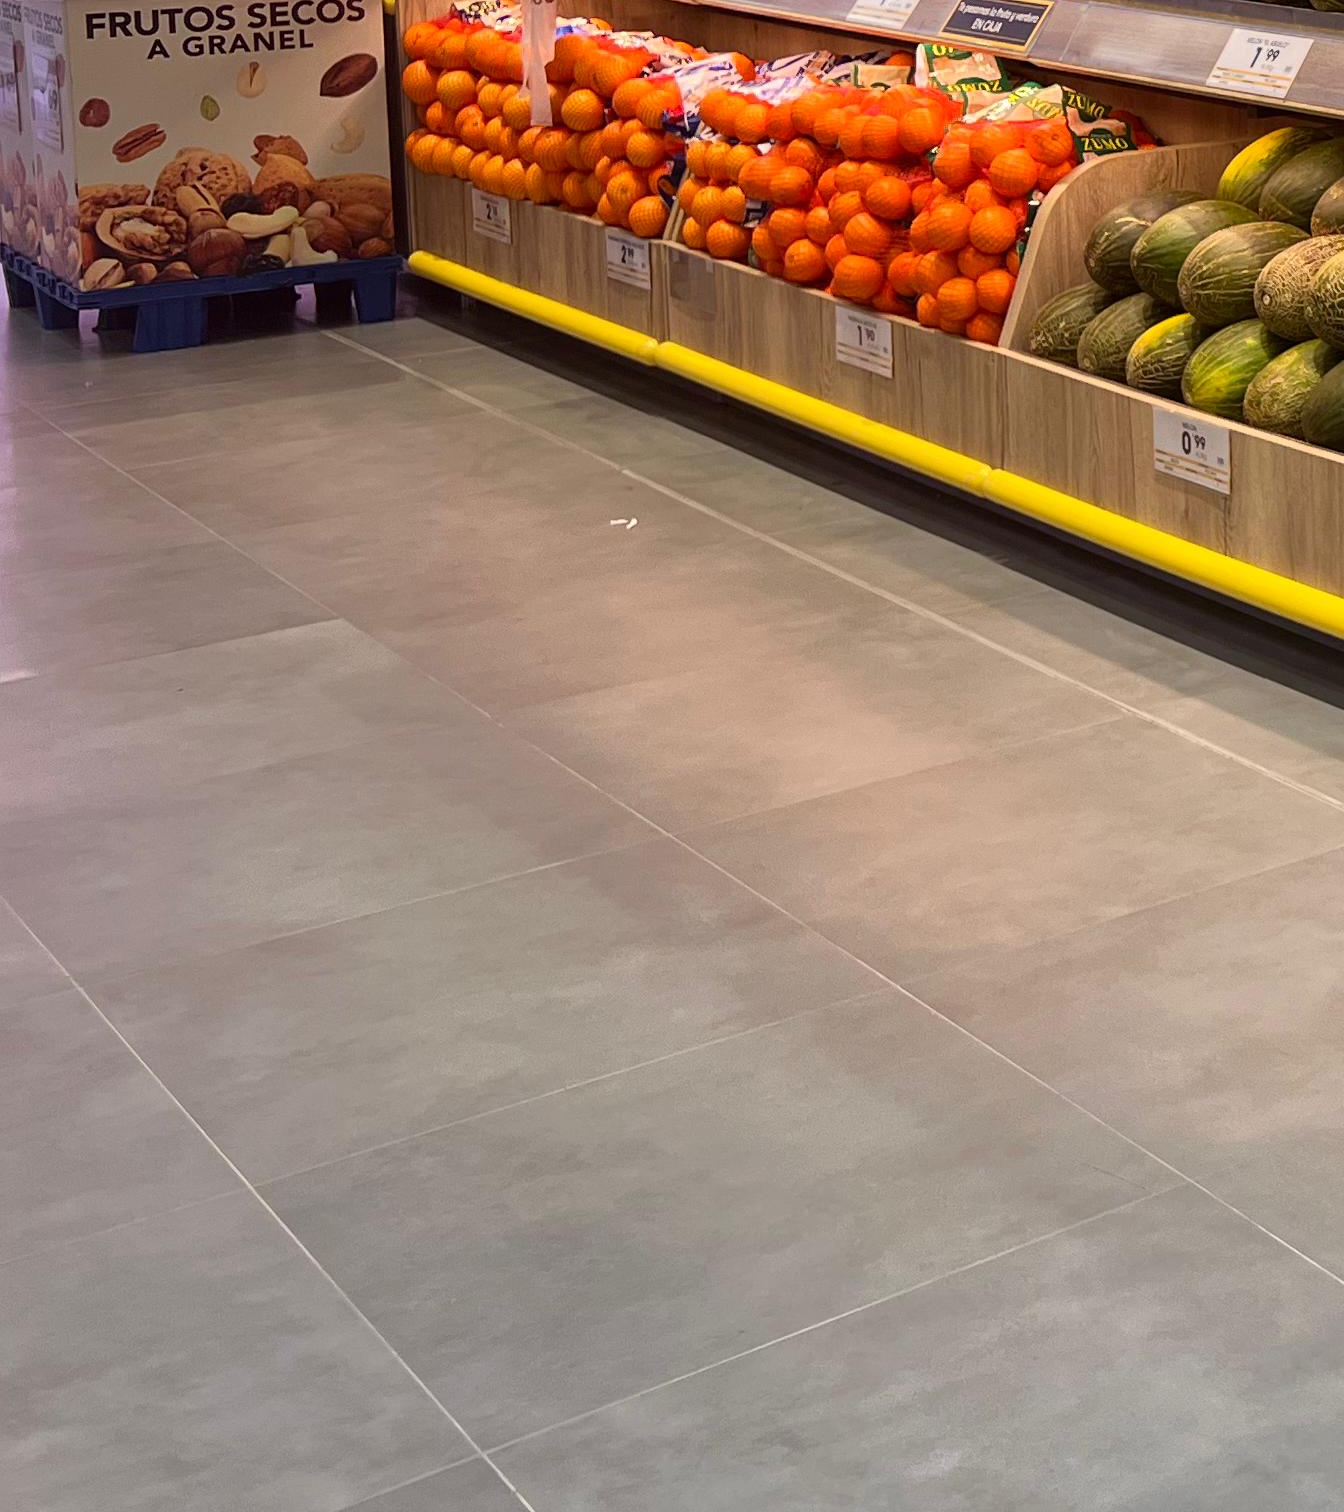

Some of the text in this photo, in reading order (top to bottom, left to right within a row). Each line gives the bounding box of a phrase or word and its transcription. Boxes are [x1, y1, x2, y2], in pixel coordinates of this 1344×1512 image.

[85, 5, 236, 39] FRUTOS
[971, 18, 1003, 33] EN CAJA
[147, 29, 314, 59] A GRANEL
[1082, 136, 1129, 152] ZUMO
